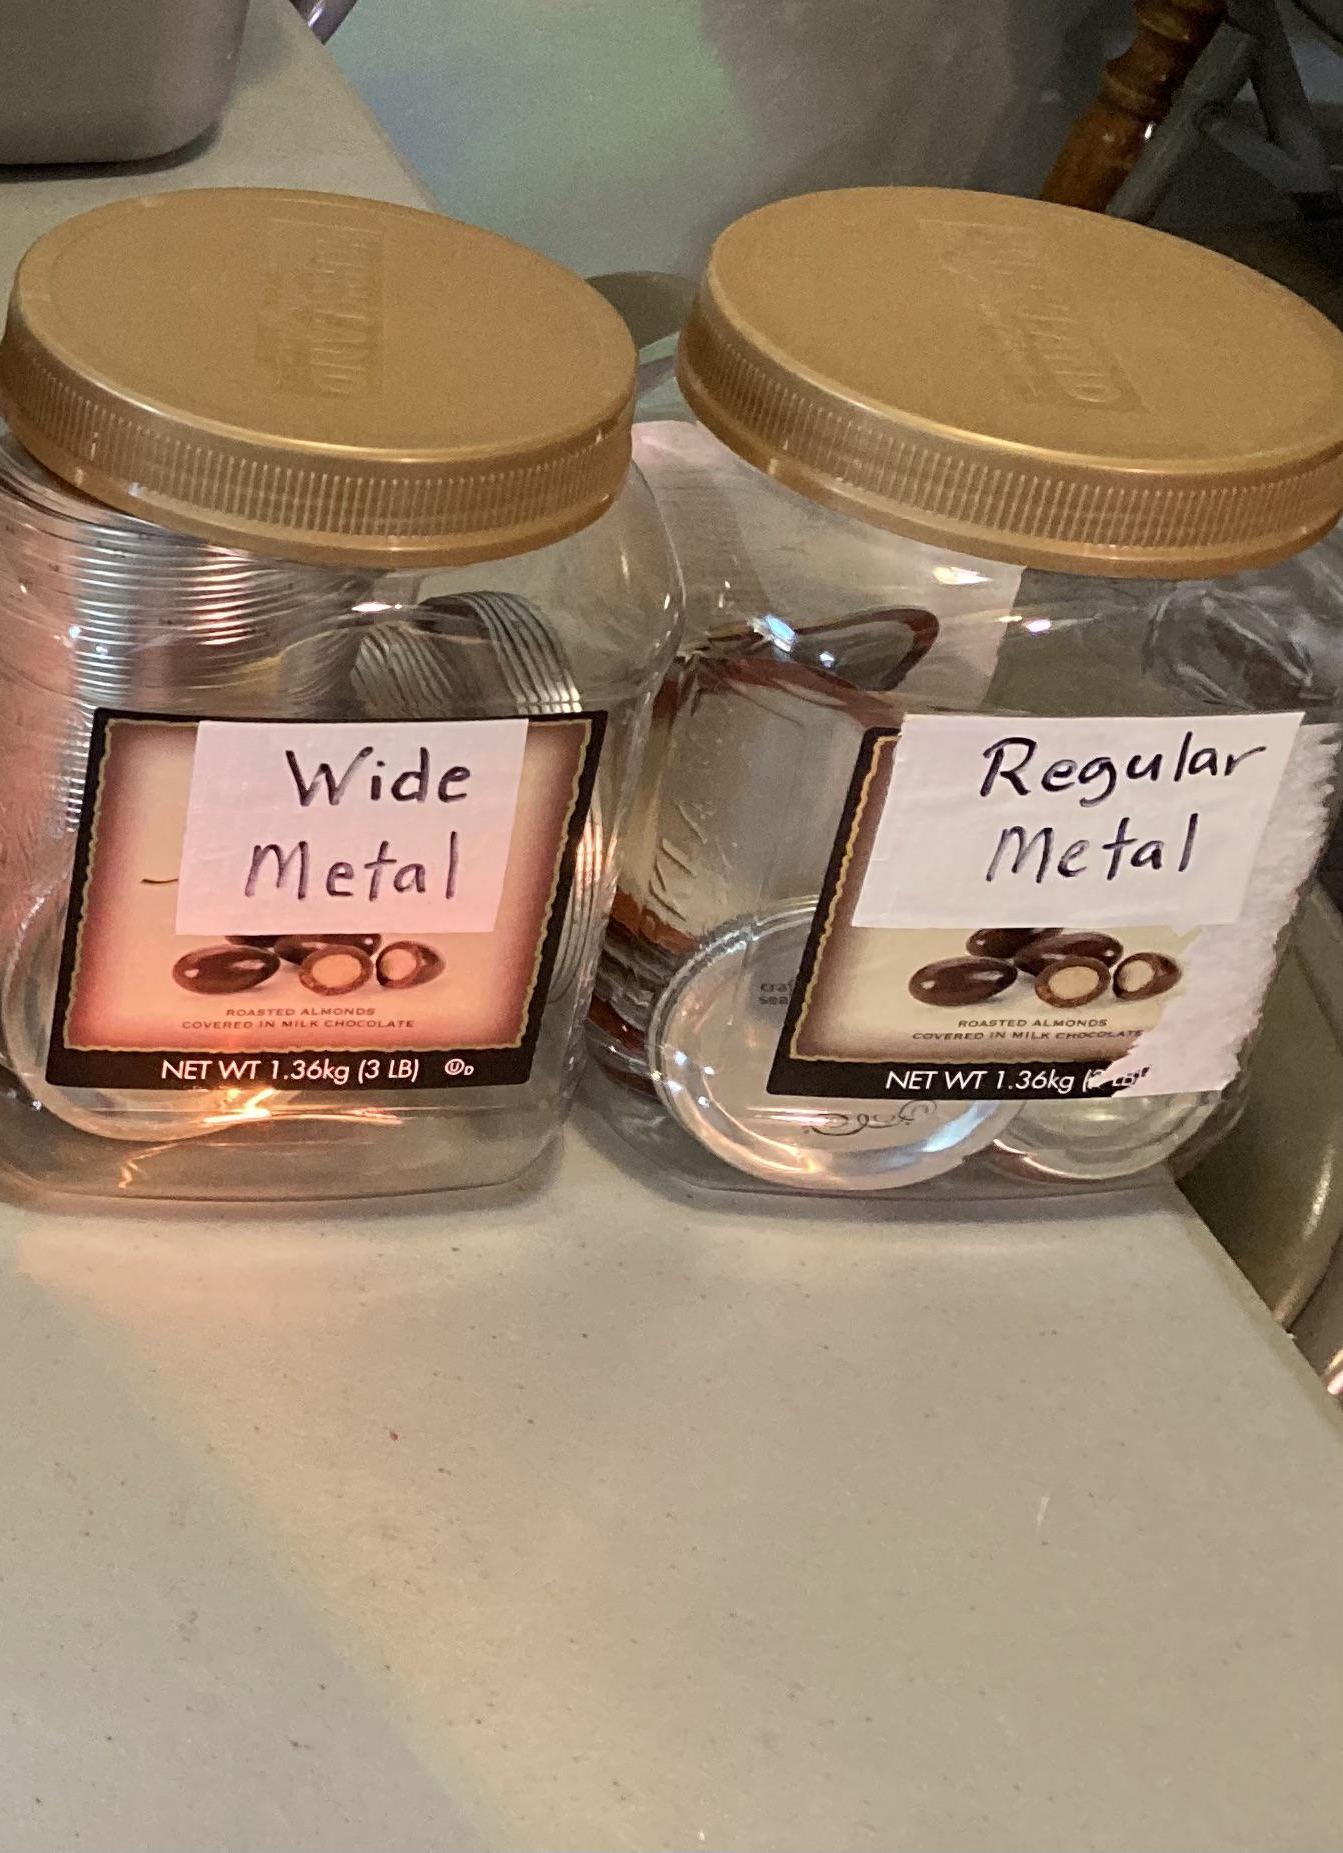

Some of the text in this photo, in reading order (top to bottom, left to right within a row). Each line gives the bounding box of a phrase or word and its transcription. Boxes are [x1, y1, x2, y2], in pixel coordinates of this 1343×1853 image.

[284, 746, 471, 806] Wide
[978, 731, 1268, 808] Regular
[985, 812, 1200, 884] Metal
[244, 831, 459, 901] Metal
[181, 1019, 415, 1029] COVERED IN MILK CHOCOLATE
[225, 1007, 377, 1017] ROASTED ALMONDS
[957, 1018, 1109, 1029] ROASTED ALMONDS
[912, 1029, 1143, 1041] COVERED IN MILK CHOCOLATE
[161, 1060, 212, 1080] NET
[218, 1060, 262, 1080] WT
[270, 1059, 350, 1085] 1.36kg
[357, 1058, 381, 1085] (3
[387, 1058, 420, 1084] LB)
[885, 1070, 939, 1090] NET
[944, 1070, 988, 1090] WT
[995, 1069, 1076, 1095] 1.36kg
